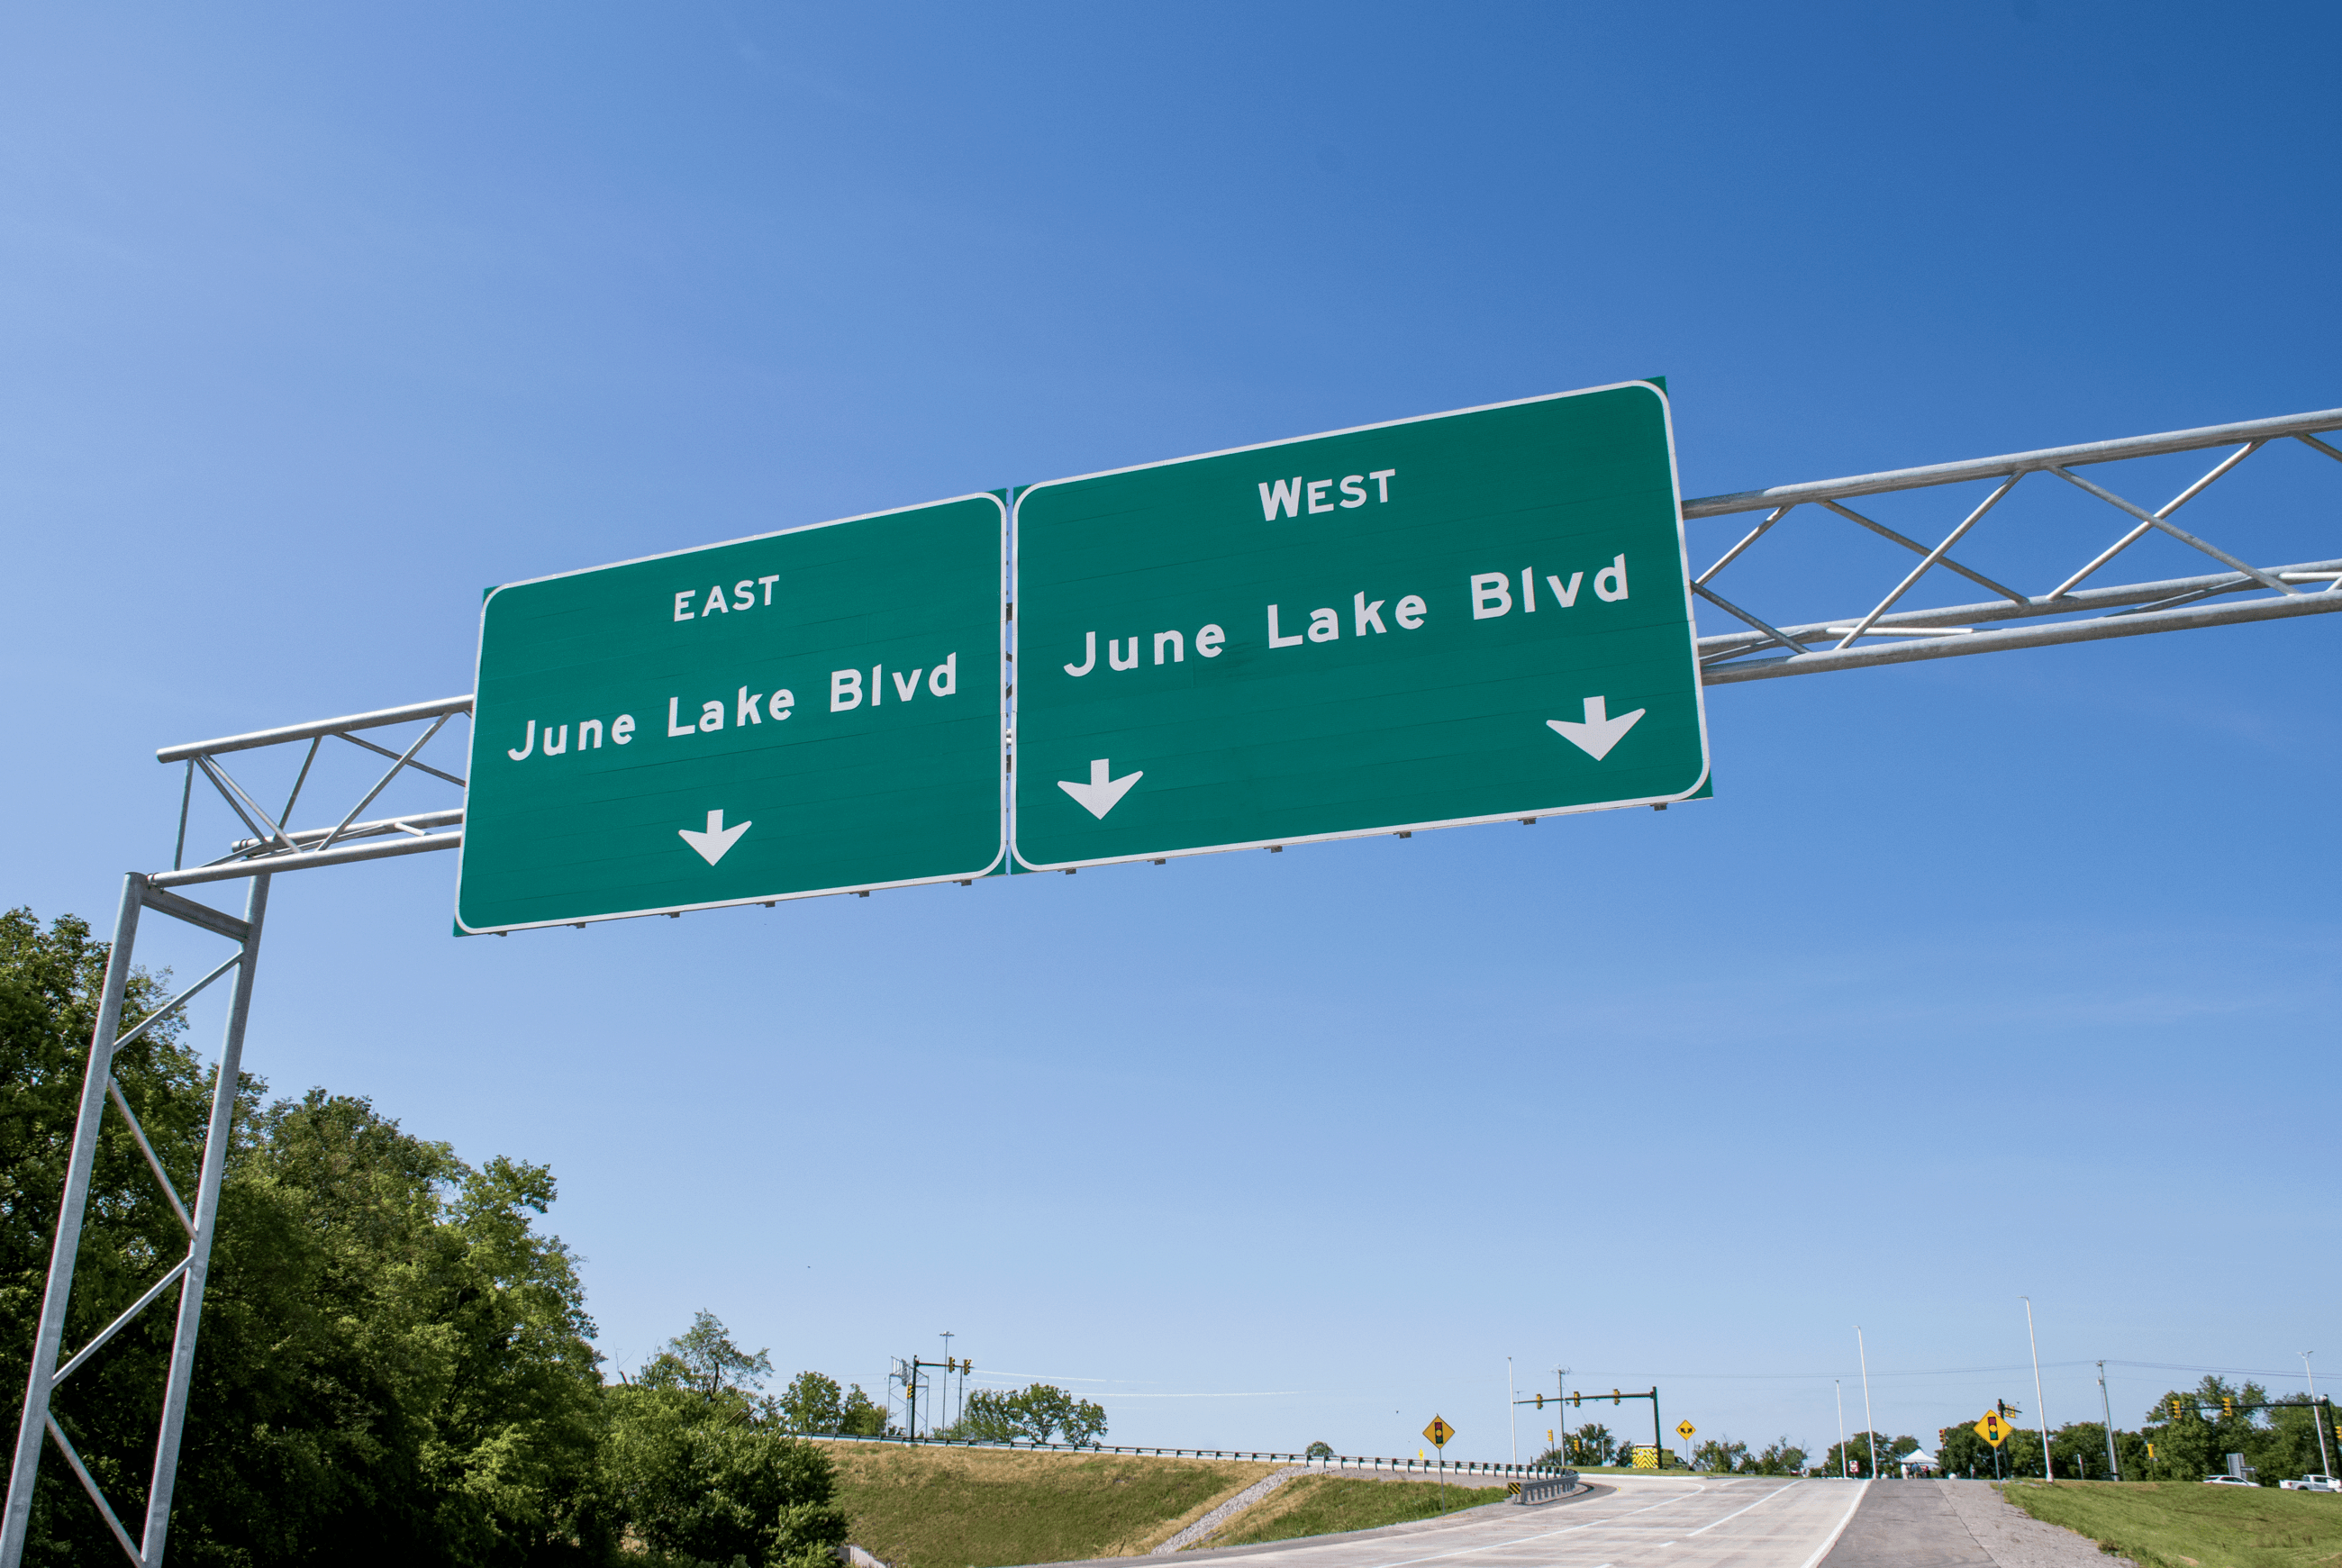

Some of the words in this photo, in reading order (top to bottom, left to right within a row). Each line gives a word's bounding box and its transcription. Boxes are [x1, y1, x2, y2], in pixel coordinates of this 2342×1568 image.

[1257, 468, 1395, 521] WEST
[673, 575, 780, 622] EAST
[1063, 623, 1227, 677] June
[1266, 591, 1428, 649] Lake
[1471, 553, 1629, 621] Blvd
[507, 713, 636, 762] June
[667, 685, 794, 738] Lake
[830, 651, 957, 712] Blvd
